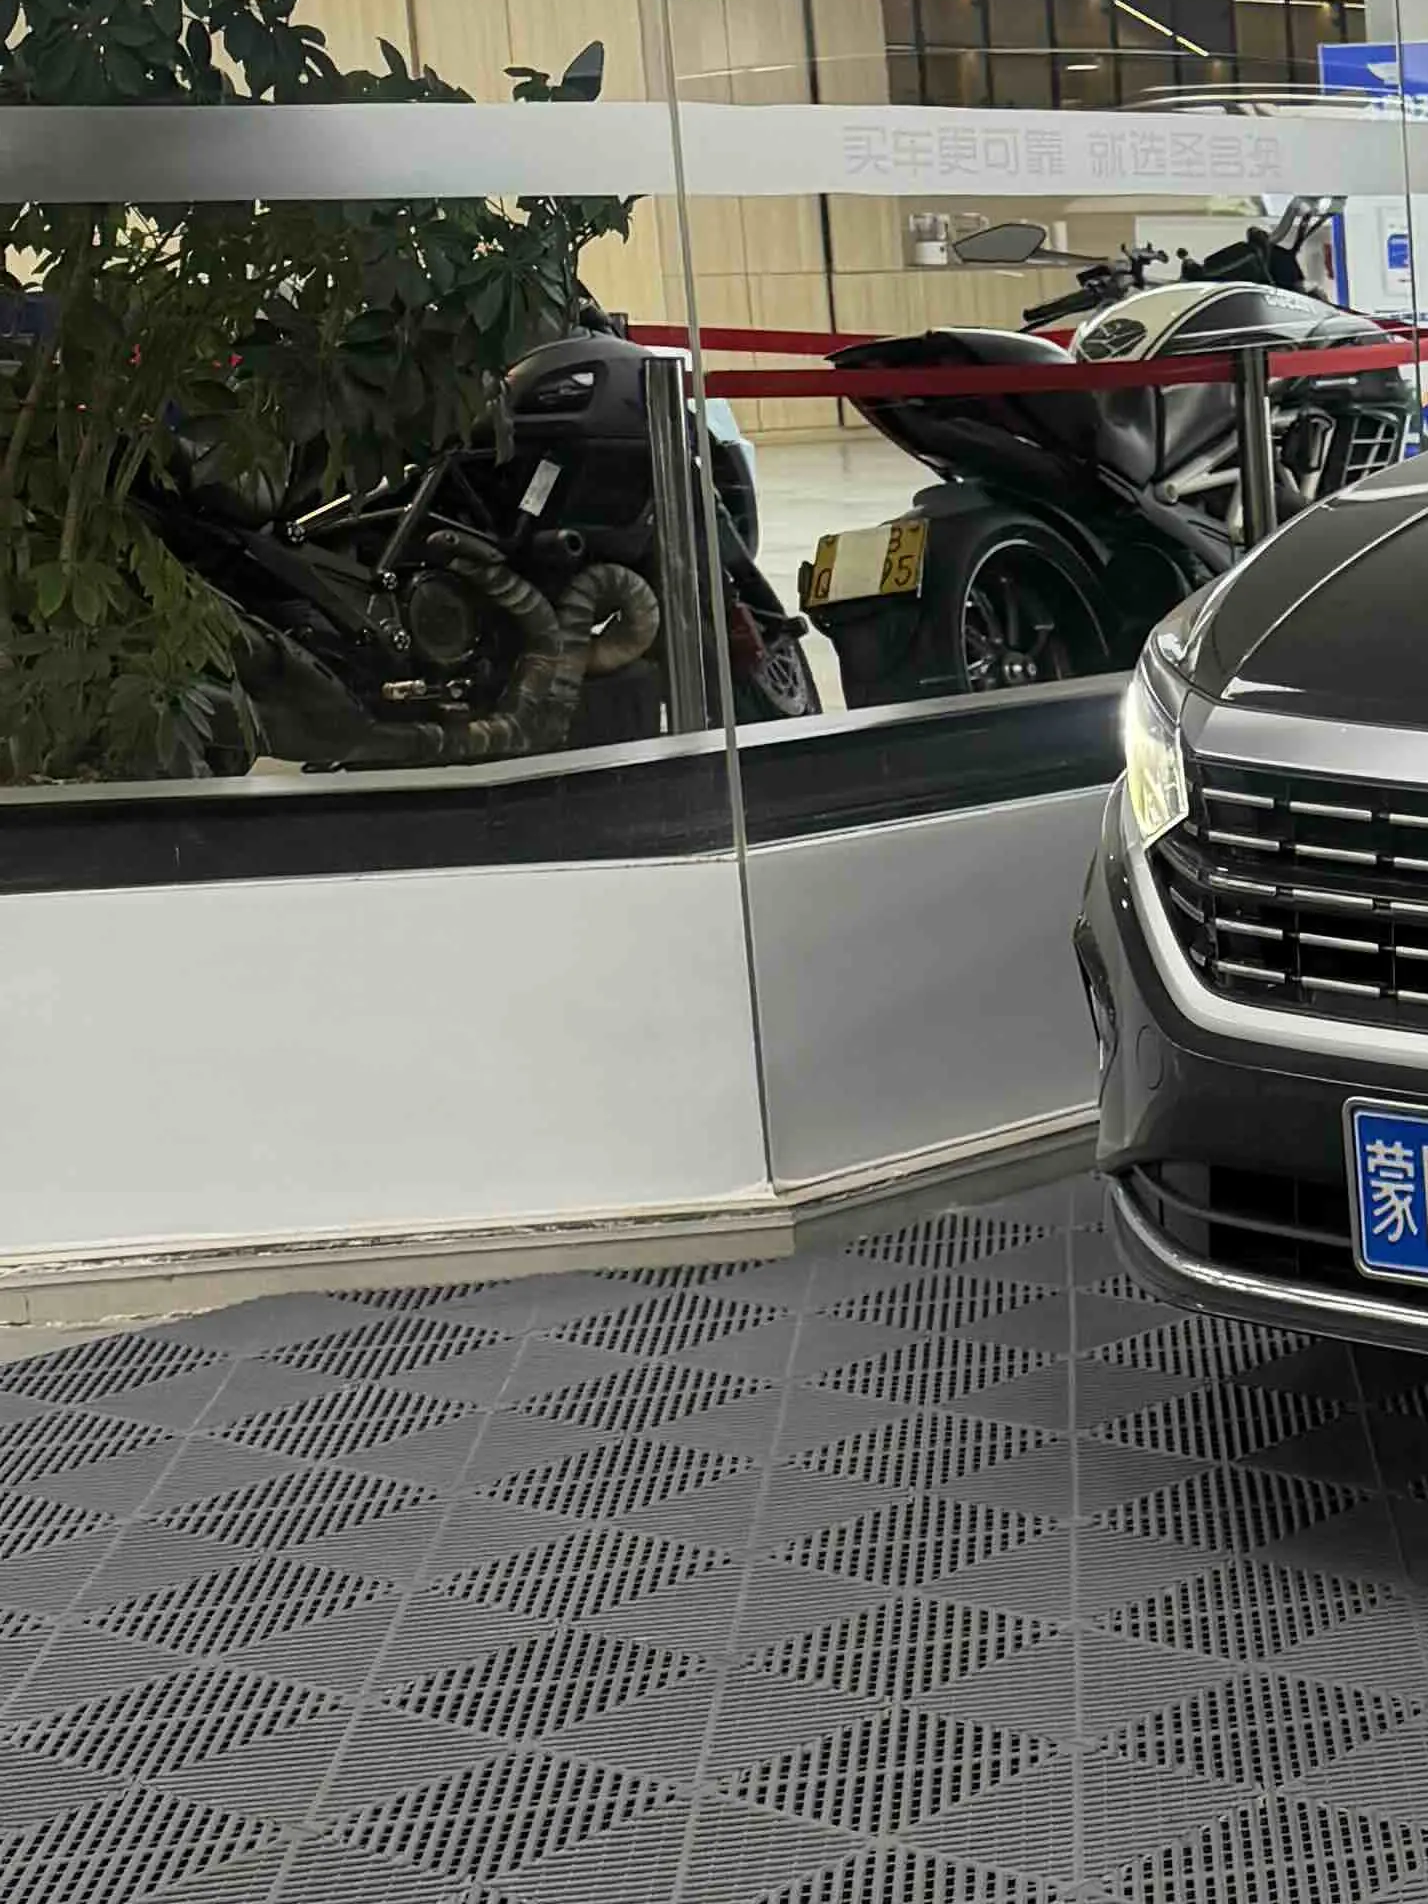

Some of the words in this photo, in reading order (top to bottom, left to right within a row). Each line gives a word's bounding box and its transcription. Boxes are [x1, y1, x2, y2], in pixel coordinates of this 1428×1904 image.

[842, 125, 1067, 177] 买车更可靠
